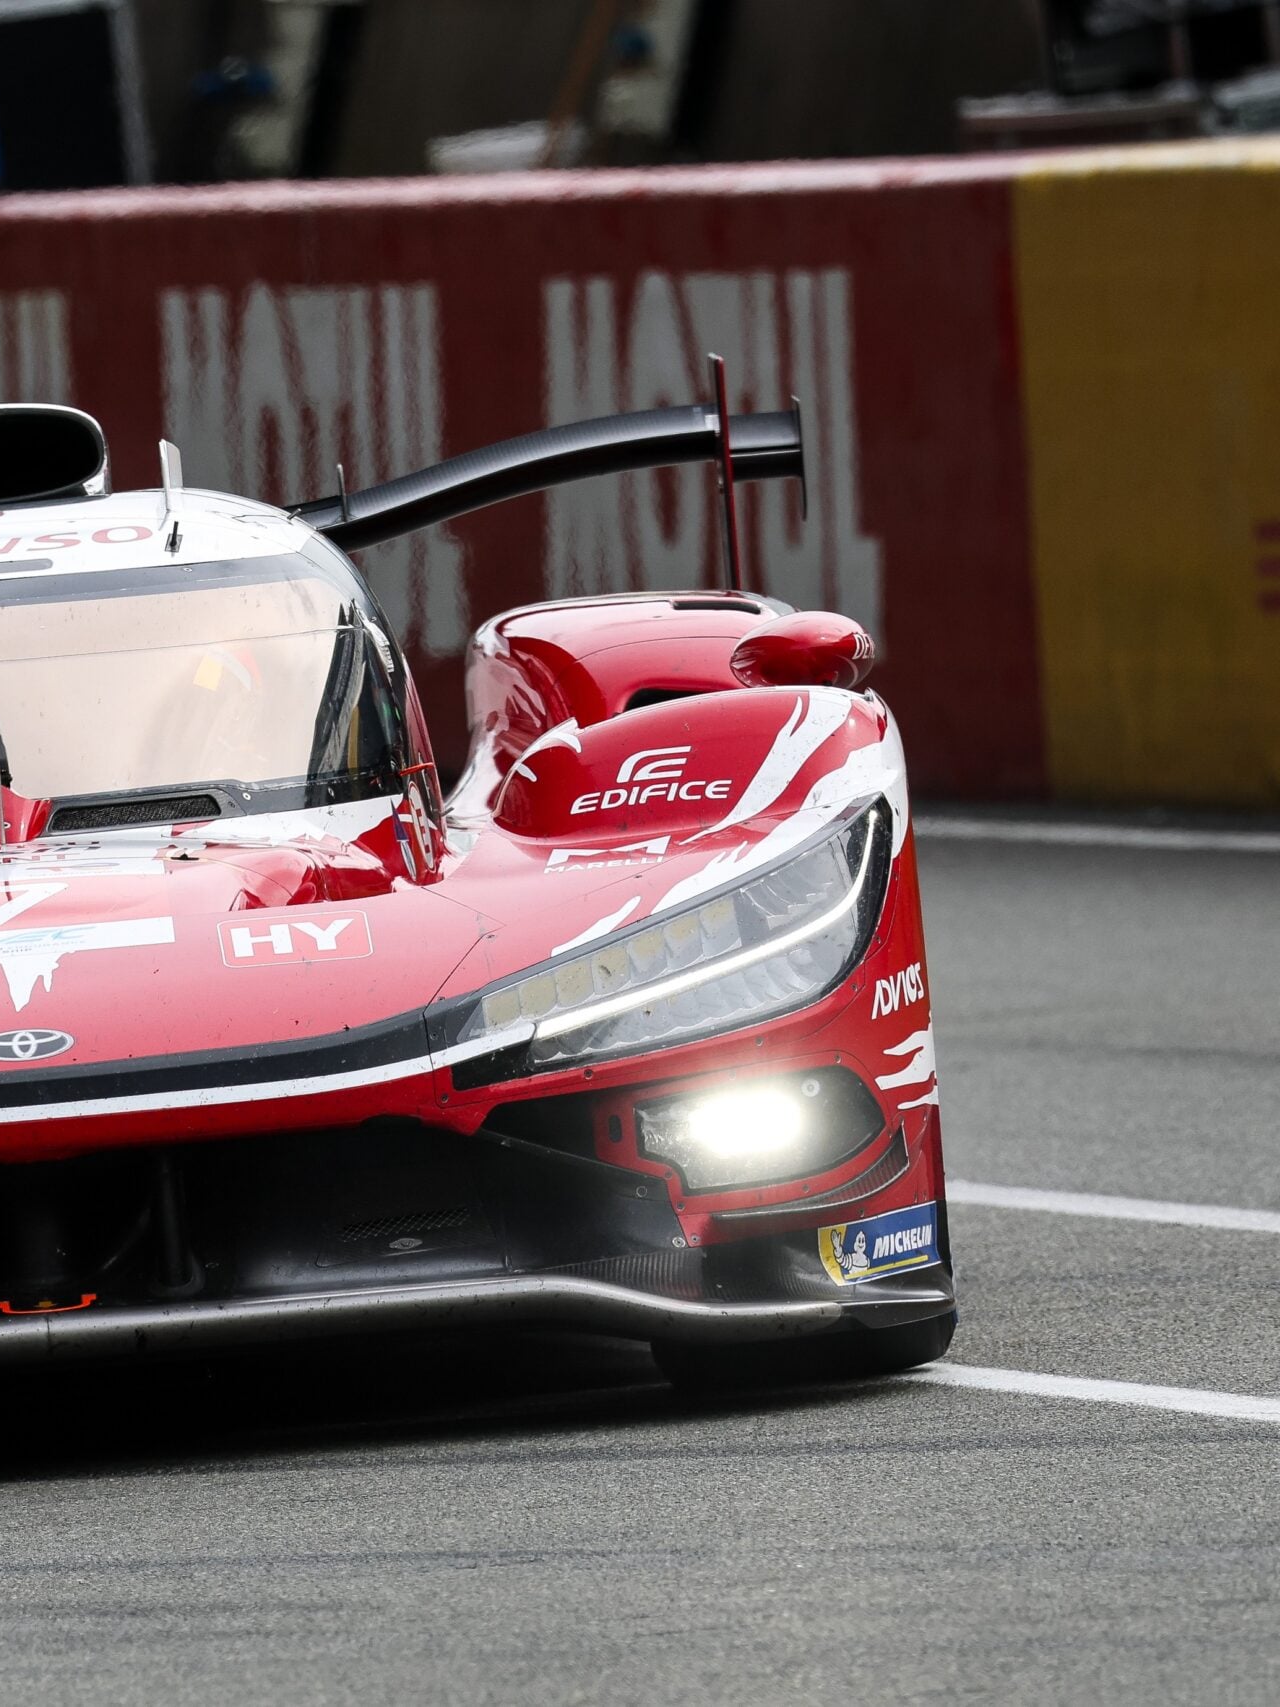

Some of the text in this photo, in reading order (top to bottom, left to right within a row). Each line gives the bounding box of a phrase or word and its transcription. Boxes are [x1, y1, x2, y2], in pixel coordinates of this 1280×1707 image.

[570, 780, 732, 815] EDIFICE
[544, 856, 666, 874] MARELLI
[229, 918, 355, 958] HY
[872, 1224, 933, 1260] MICHELIN
